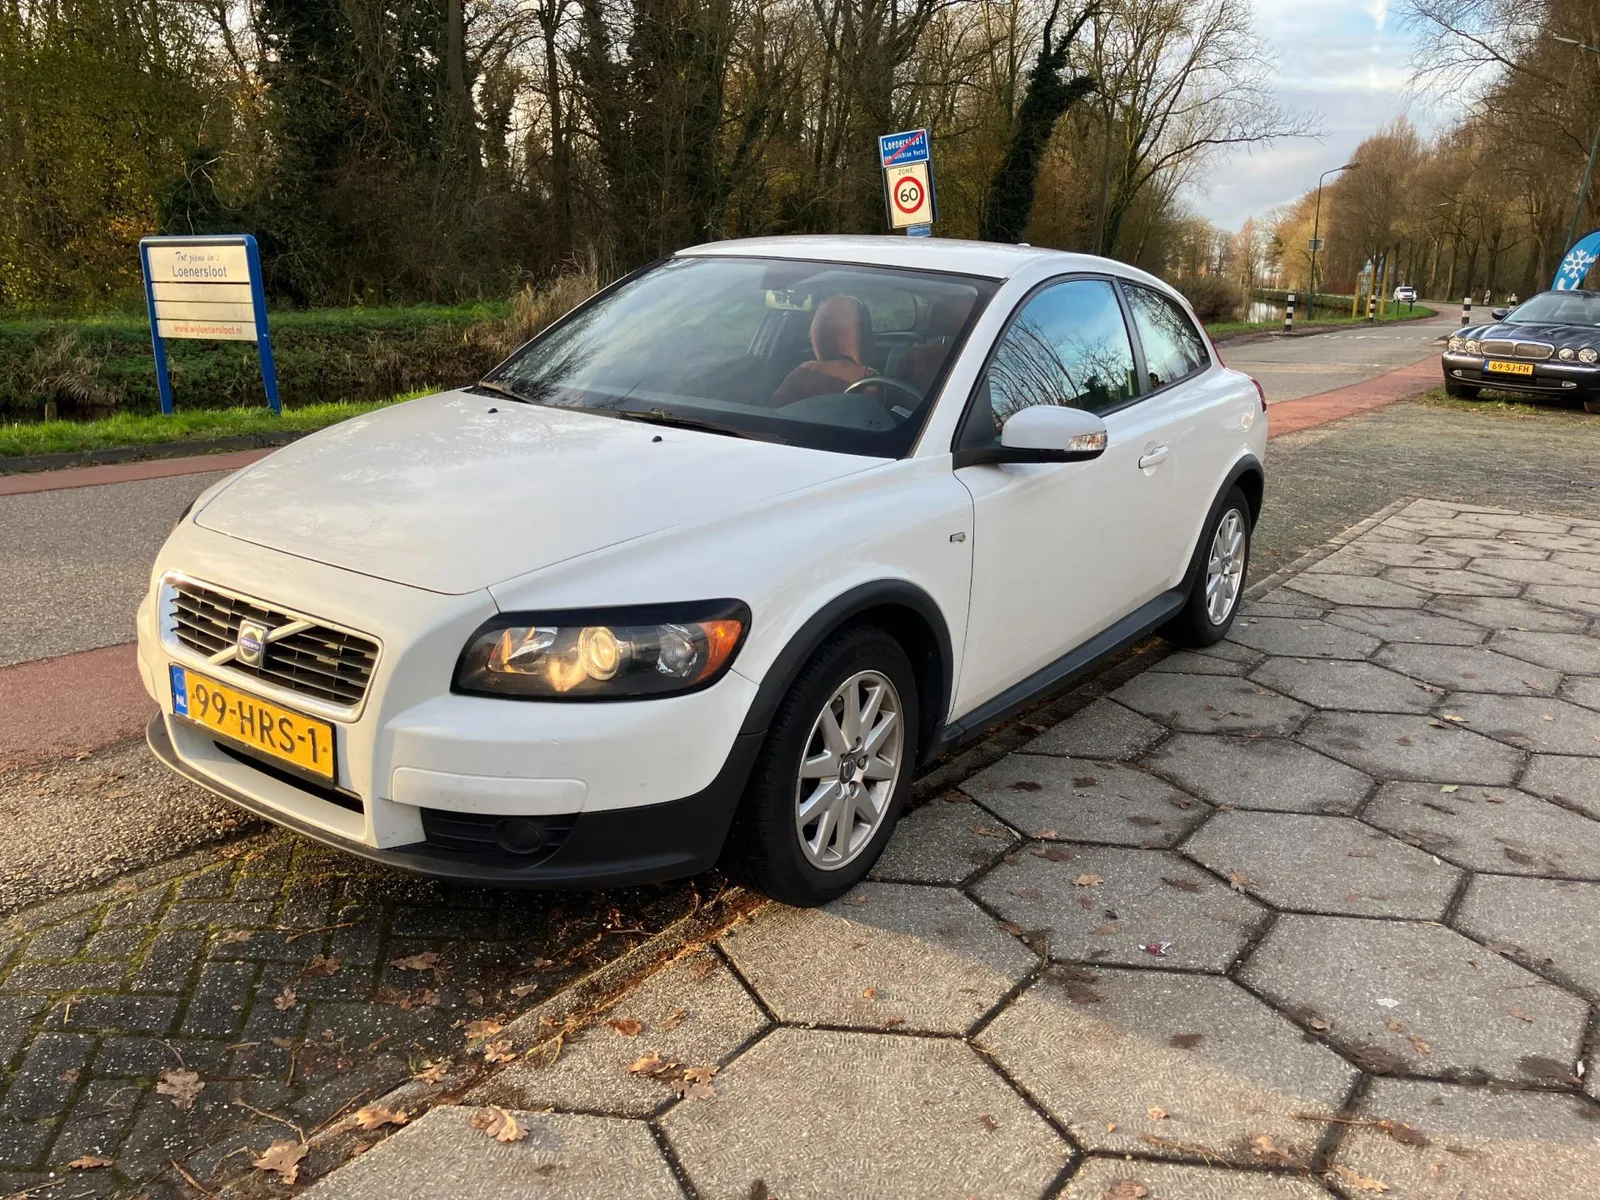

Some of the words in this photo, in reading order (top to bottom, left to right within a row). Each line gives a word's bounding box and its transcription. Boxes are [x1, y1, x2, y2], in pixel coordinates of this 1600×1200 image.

[898, 167, 914, 175] ZONE
[900, 187, 919, 202] 60
[171, 265, 227, 278] Loenersloot
[176, 694, 188, 708] NL
[195, 683, 318, 763] 99-HRS-1
